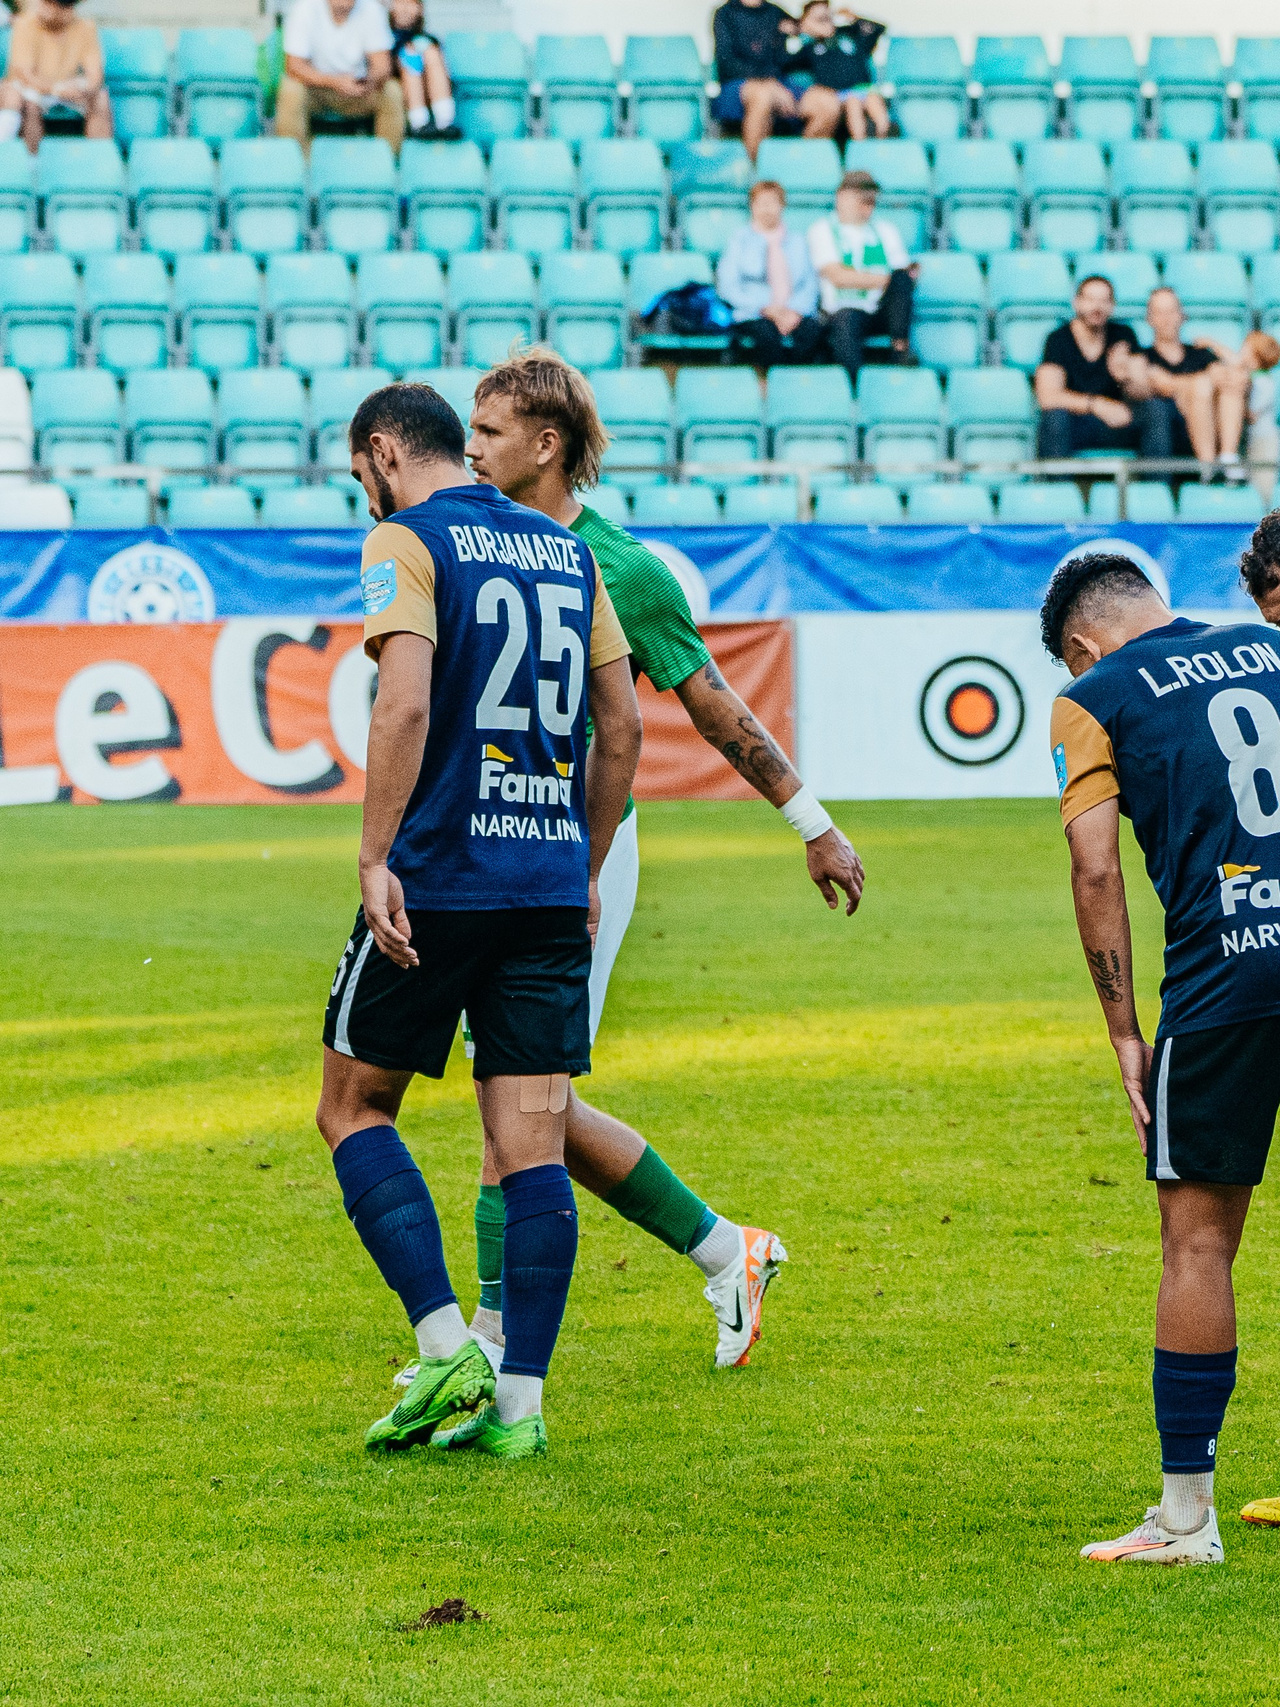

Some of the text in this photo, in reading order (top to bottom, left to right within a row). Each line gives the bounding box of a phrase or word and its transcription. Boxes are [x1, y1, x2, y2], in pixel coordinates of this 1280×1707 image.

[448, 525, 584, 578] BURJANADZE
[475, 576, 585, 736] 25
[0, 659, 176, 805] e
[479, 760, 573, 808] Fama
[470, 813, 583, 844] NARVA LINN
[1207, 1438, 1216, 1456] 8
